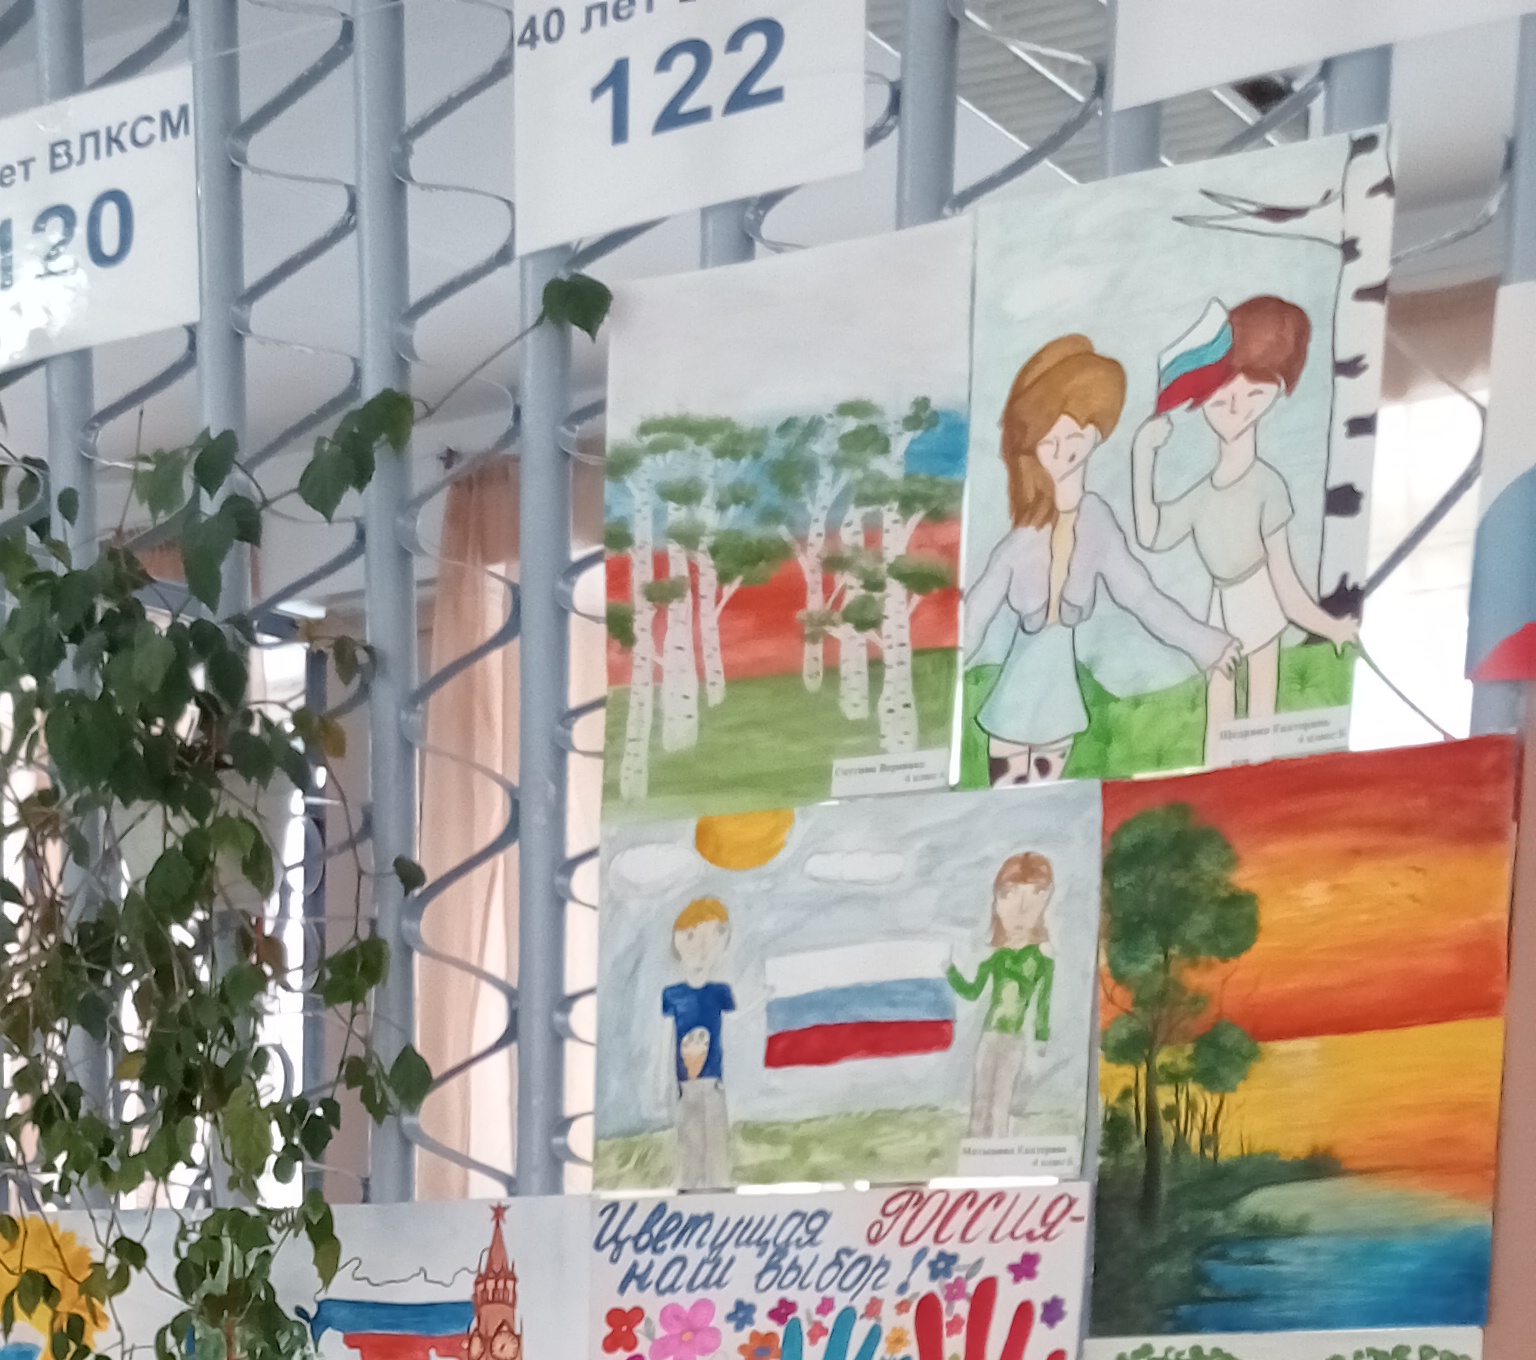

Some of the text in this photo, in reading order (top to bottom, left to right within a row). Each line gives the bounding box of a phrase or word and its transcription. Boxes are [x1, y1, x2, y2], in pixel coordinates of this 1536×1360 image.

[517, 8, 565, 50] 40
[590, 16, 785, 146] 122
[49, 103, 190, 174] ВЛКСМ
[592, 1200, 832, 1264] Цветущая
[619, 1254, 735, 1296] наш
